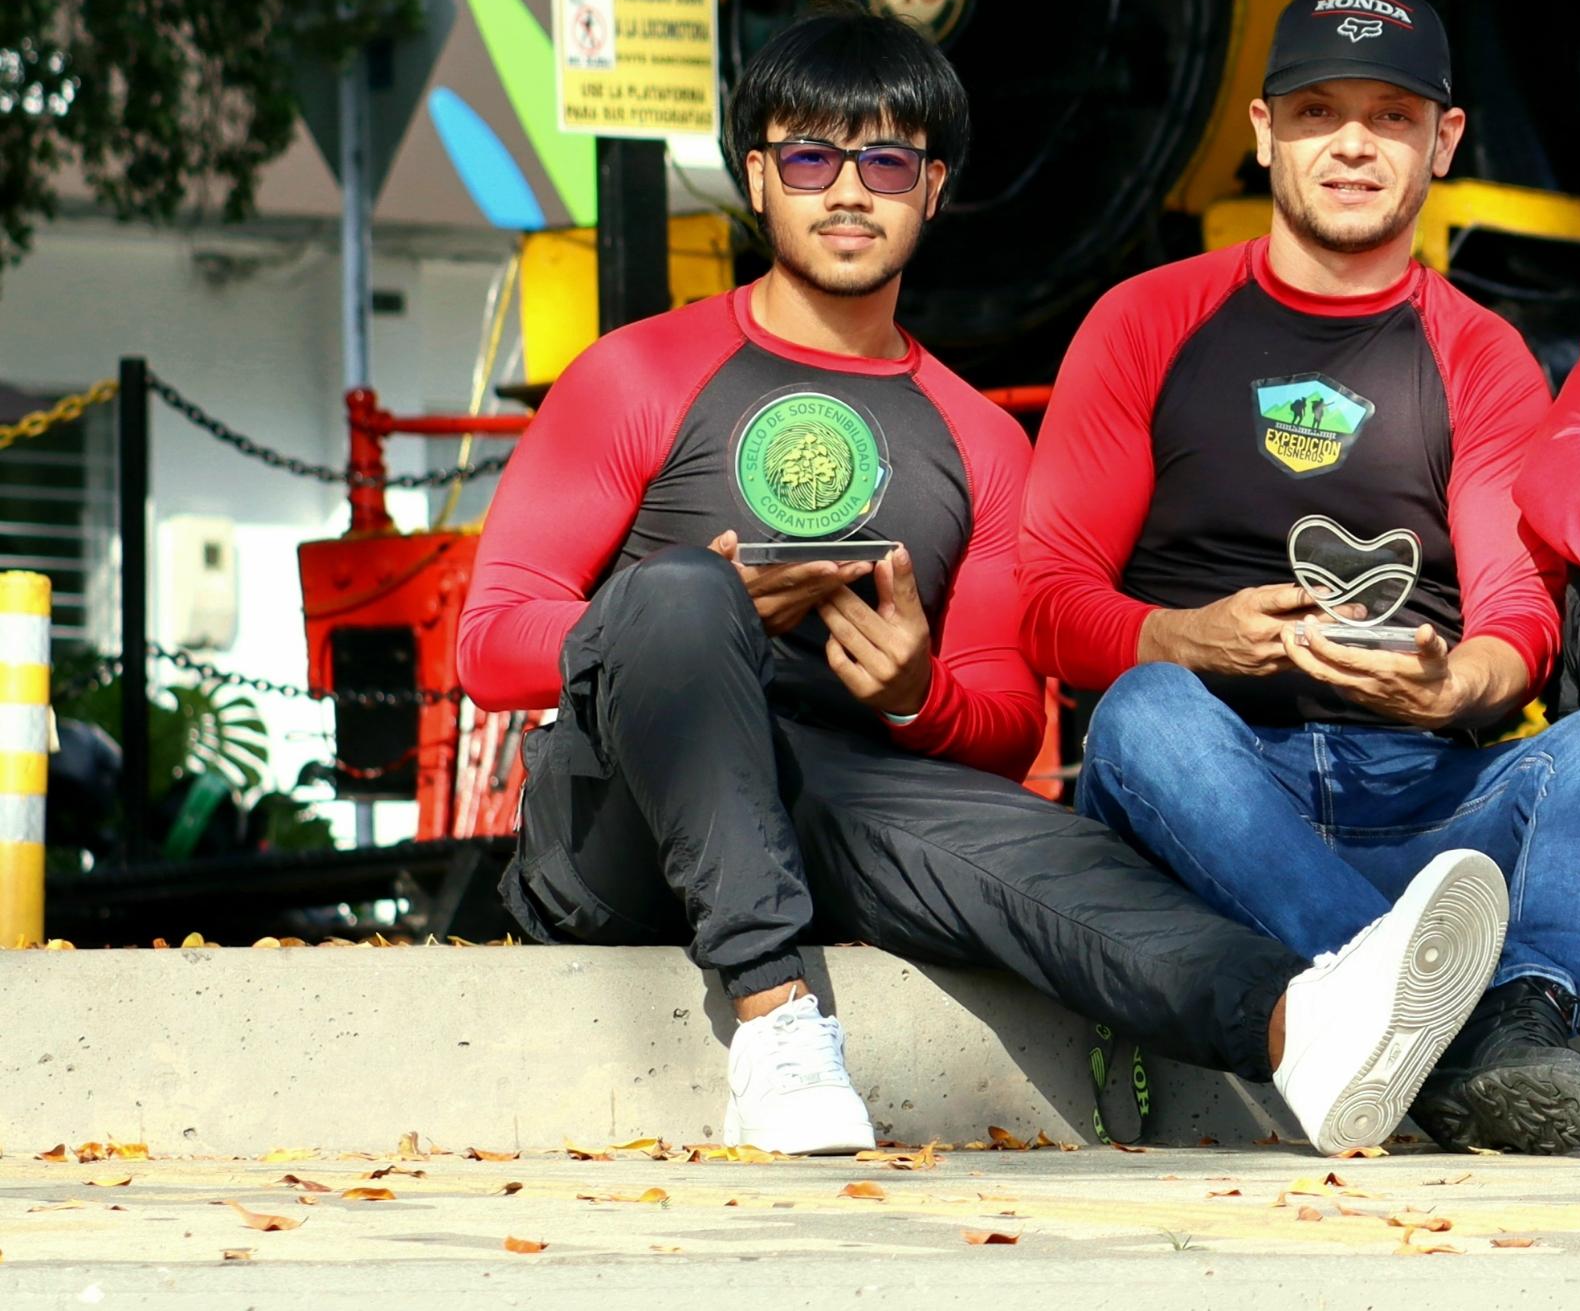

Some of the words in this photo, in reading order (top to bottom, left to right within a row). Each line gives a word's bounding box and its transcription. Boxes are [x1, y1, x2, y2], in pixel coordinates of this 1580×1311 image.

[610, 84, 624, 99] LA
[628, 85, 706, 103] PLATAFORMA
[746, 428, 767, 472] SELLO
[766, 410, 786, 429] DE
[788, 403, 871, 473] SOSTENIBILIDAD
[1277, 445, 1324, 464] CISNEROS
[760, 495, 862, 530] CORANTIOQUIA
